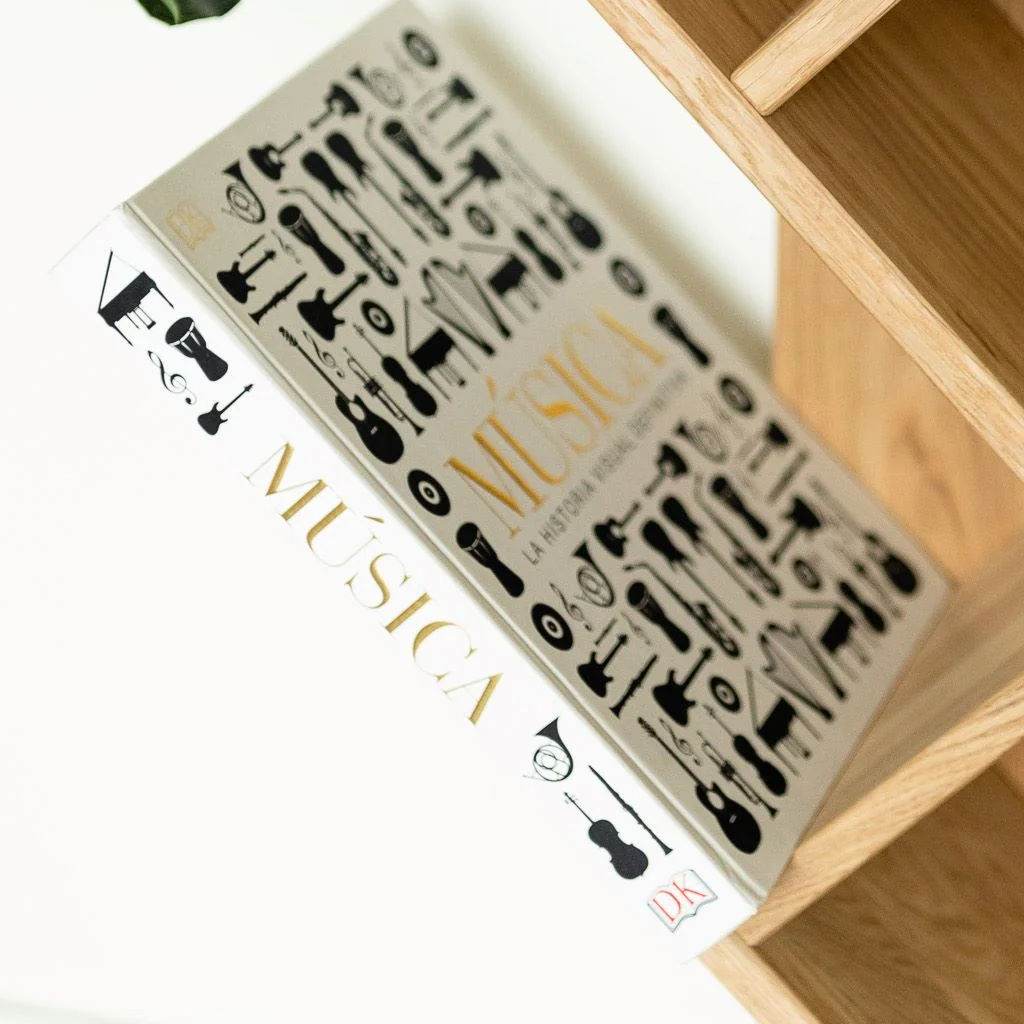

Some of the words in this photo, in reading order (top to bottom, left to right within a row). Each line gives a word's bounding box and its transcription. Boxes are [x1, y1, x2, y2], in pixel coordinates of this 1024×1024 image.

[443, 306, 668, 538] MÚSICA
[240, 440, 503, 726] MÚSICA
[521, 541, 545, 566] LA
[538, 478, 594, 545] HISTORIA
[652, 872, 708, 923] DK
